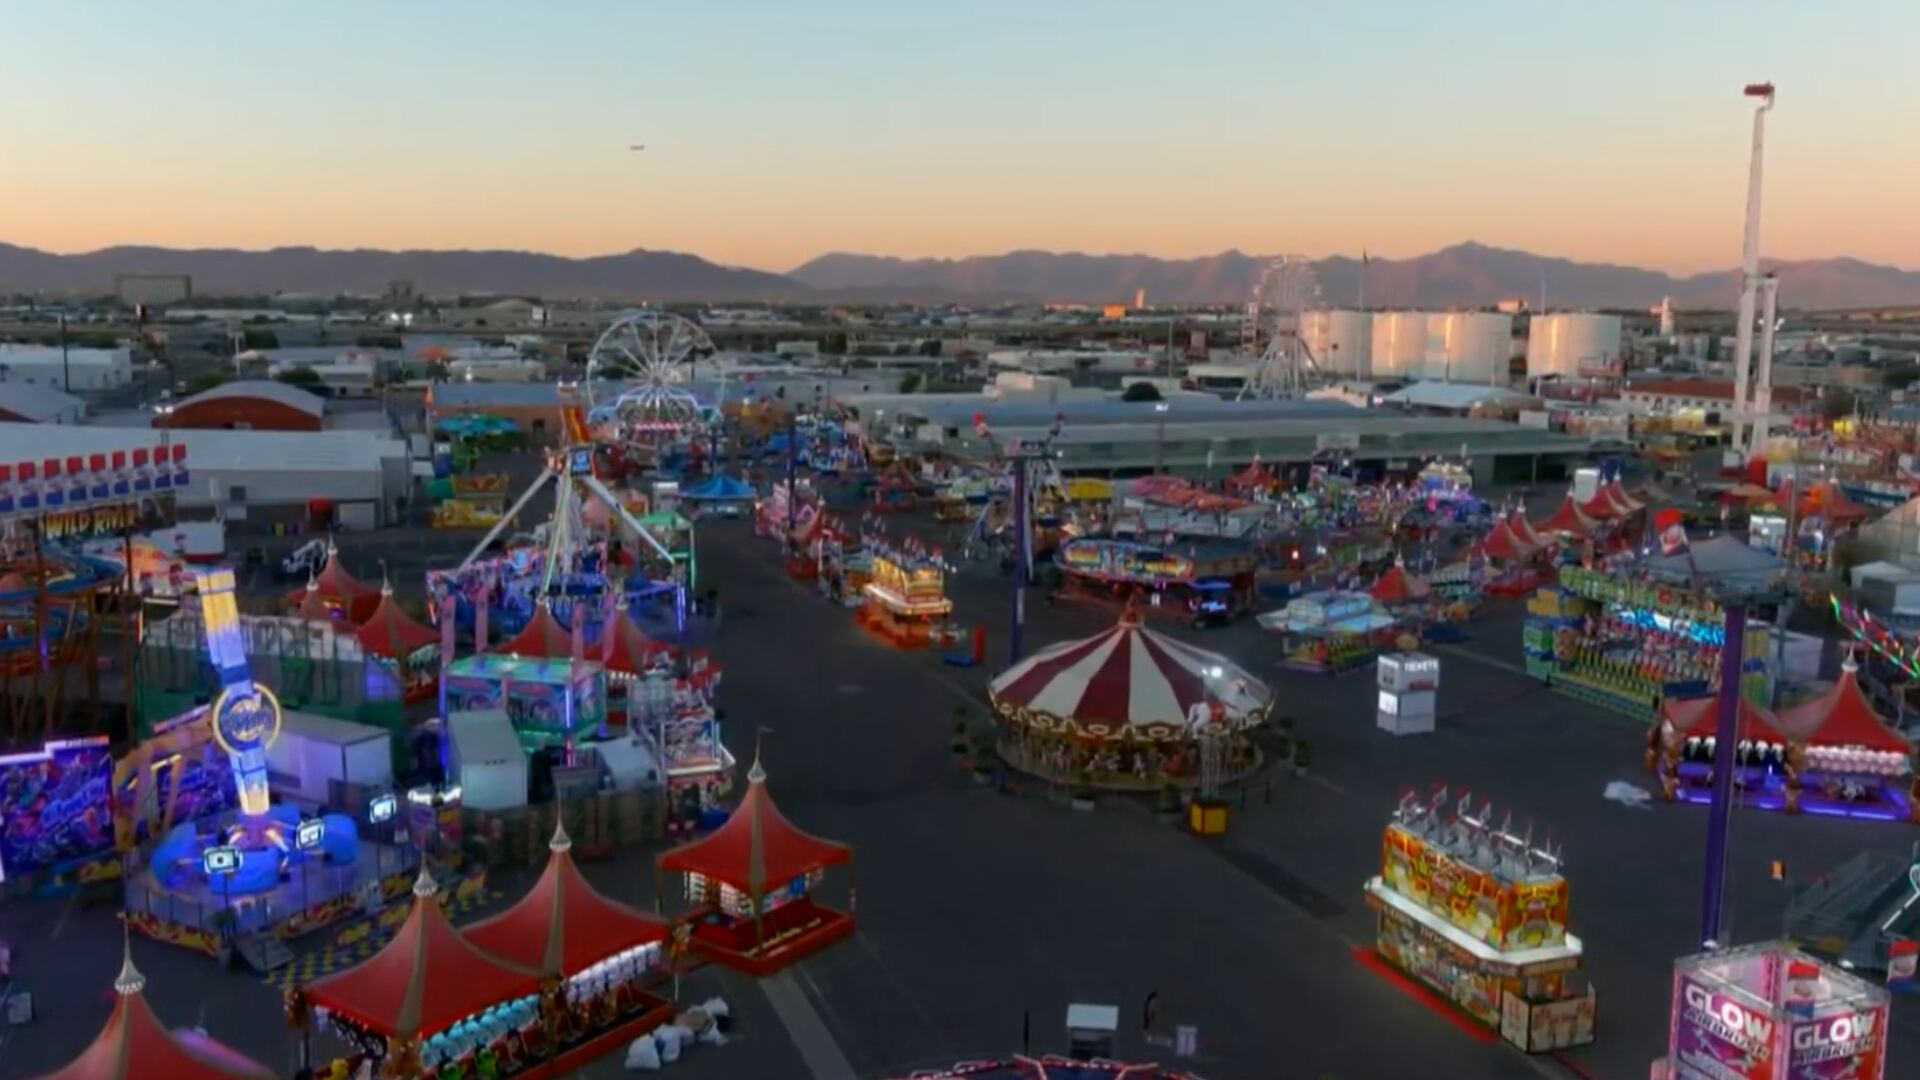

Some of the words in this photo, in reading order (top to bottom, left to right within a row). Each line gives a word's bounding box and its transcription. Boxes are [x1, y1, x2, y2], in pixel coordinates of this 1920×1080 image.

[46, 509, 90, 540] WILD
[1685, 982, 1772, 1043] GLOW
[1793, 1010, 1876, 1050] GLOW
